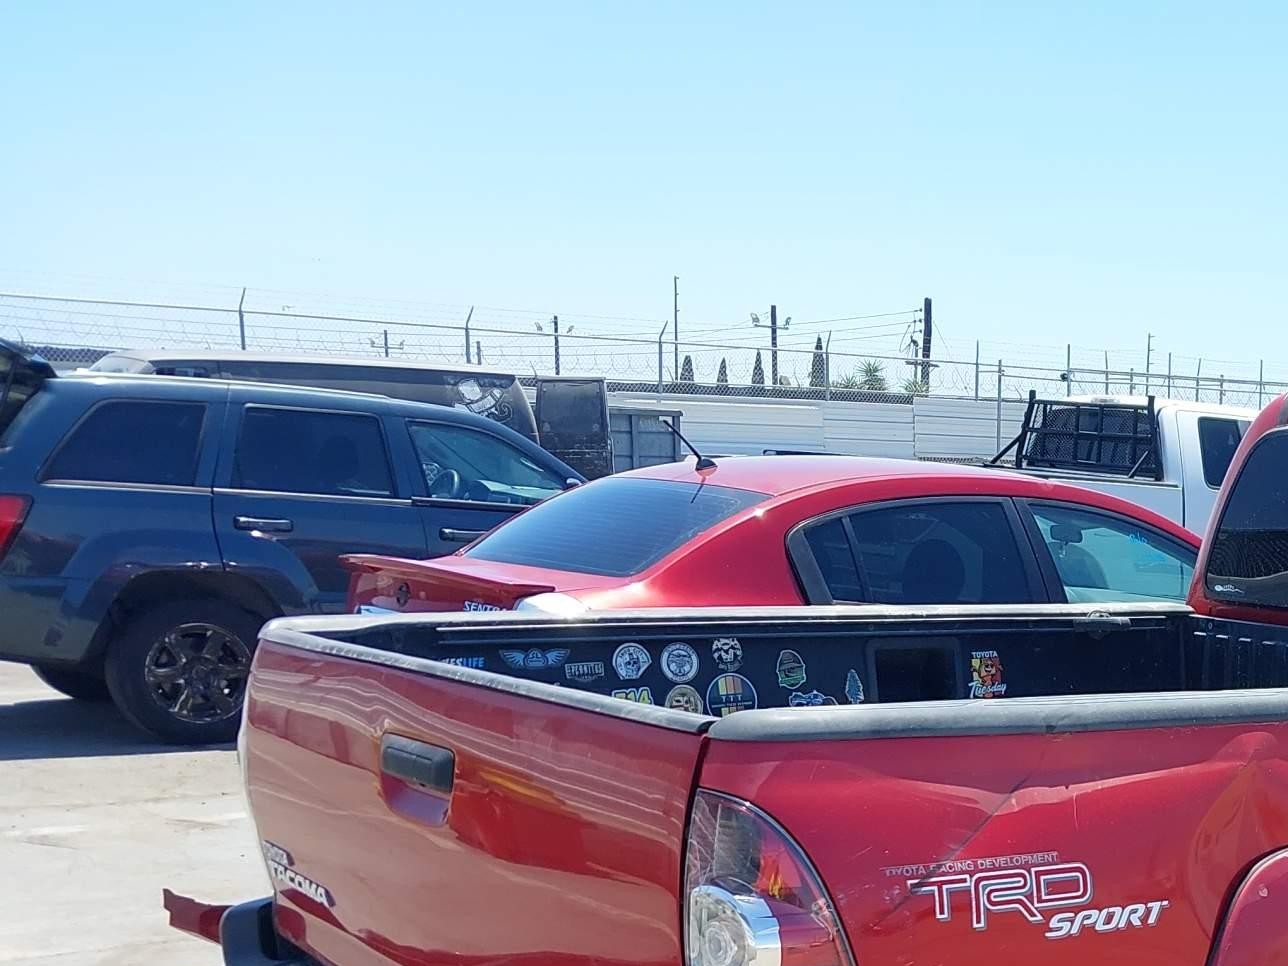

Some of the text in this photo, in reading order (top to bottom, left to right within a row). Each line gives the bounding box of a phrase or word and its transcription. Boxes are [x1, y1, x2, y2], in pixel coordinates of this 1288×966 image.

[968, 678, 1006, 699] Tuesday
[977, 853, 1058, 870] DEVELOPMENT
[269, 860, 330, 908] TACOMA
[906, 862, 1092, 929] TRD
[1045, 900, 1169, 938] SPORT
